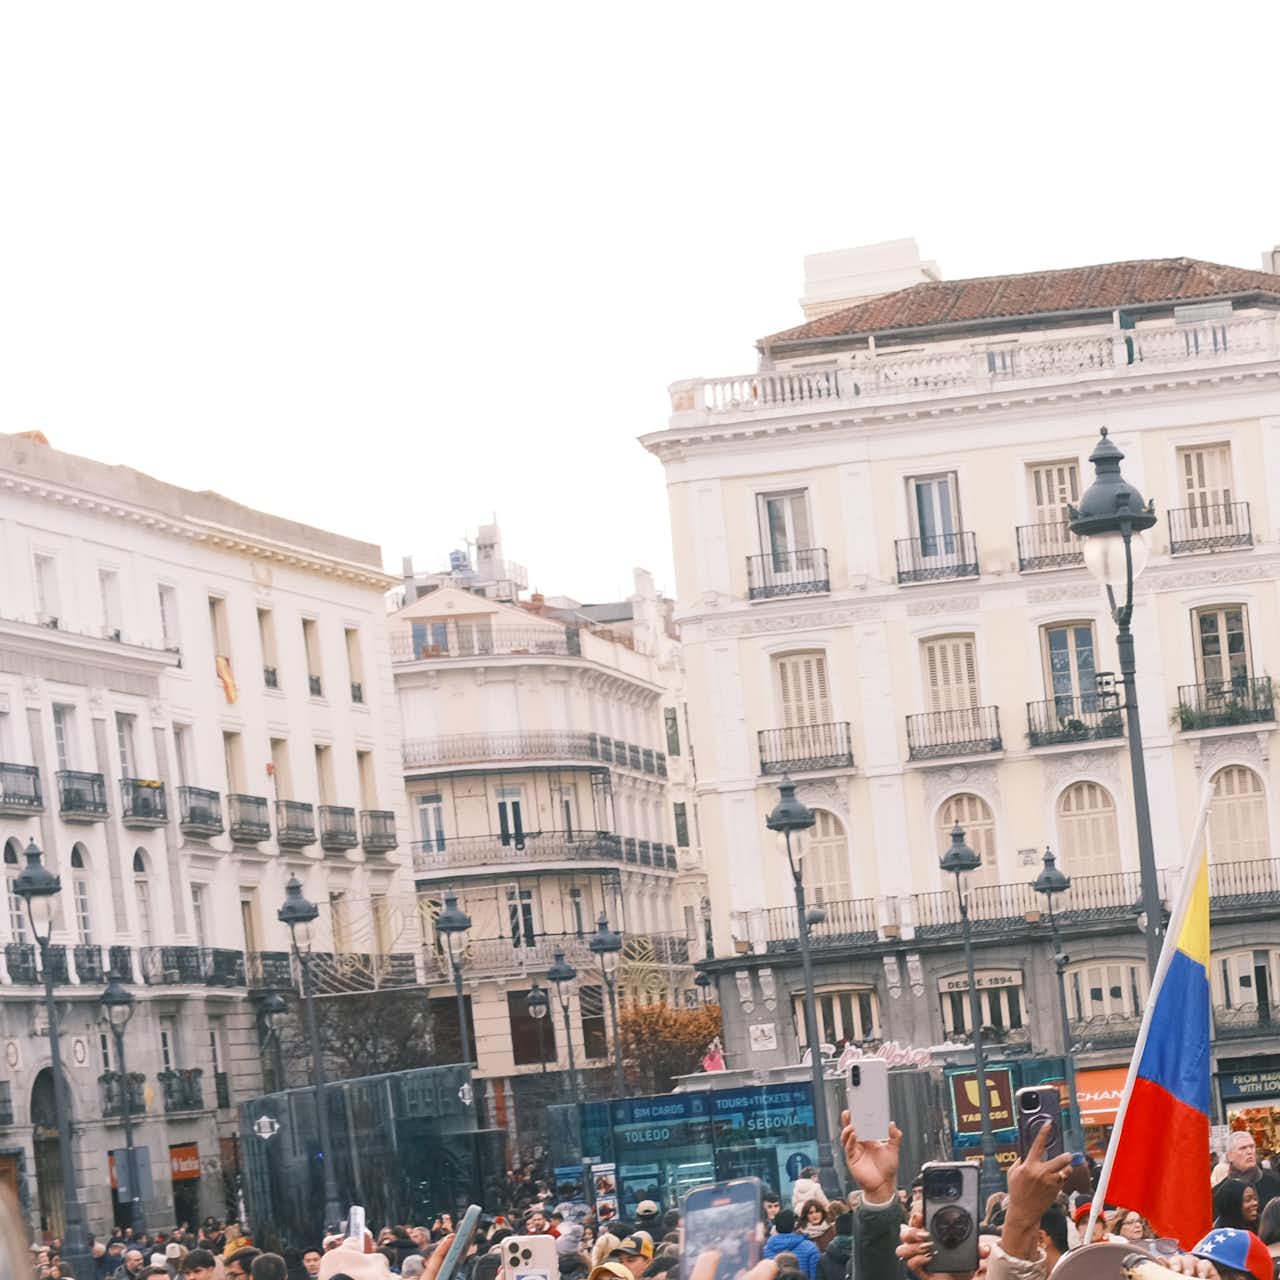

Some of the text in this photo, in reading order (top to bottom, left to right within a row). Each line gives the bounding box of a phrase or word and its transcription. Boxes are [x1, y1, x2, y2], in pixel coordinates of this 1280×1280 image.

[947, 978, 983, 990] DESE
[1240, 1083, 1262, 1093] WITH
[747, 1114, 801, 1131] SEGOVIA
[962, 1111, 1008, 1122] TABCOS
[624, 1128, 670, 1143] TOLEDO
